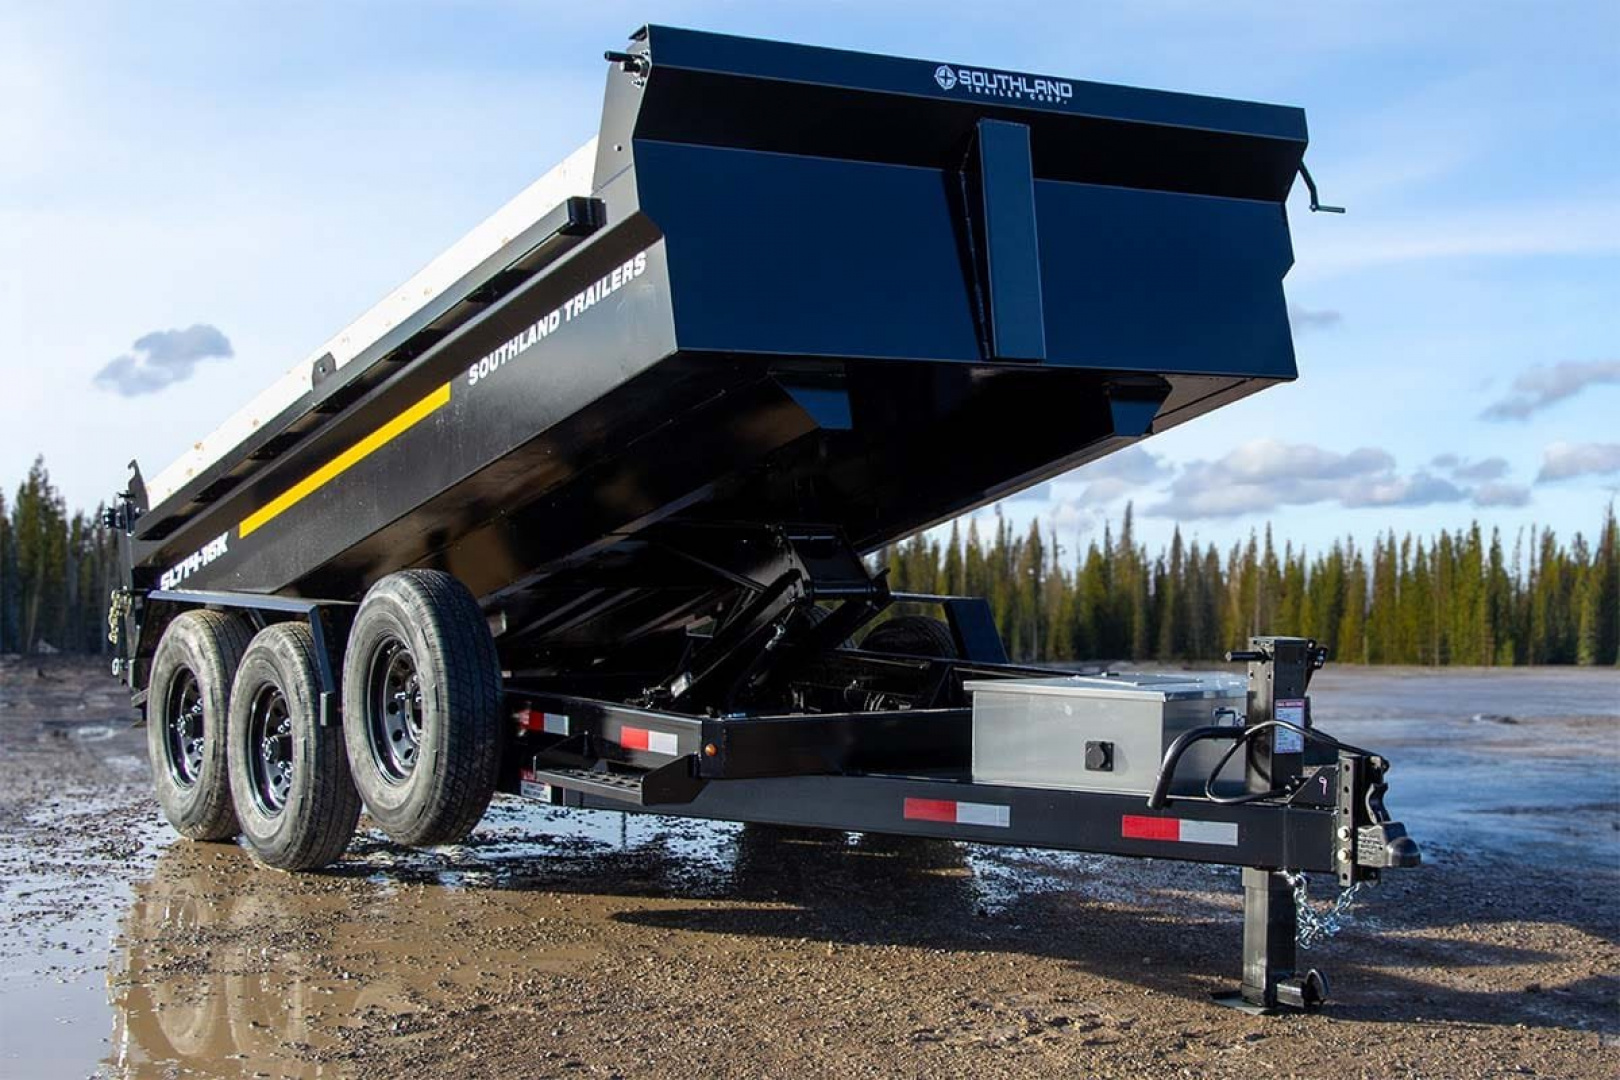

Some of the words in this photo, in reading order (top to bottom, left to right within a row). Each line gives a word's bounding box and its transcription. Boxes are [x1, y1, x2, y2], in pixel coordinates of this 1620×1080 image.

[958, 70, 1073, 98] SOUTHLAND
[468, 310, 560, 385] SOUTHLAND
[563, 251, 647, 322] TRAILERS
